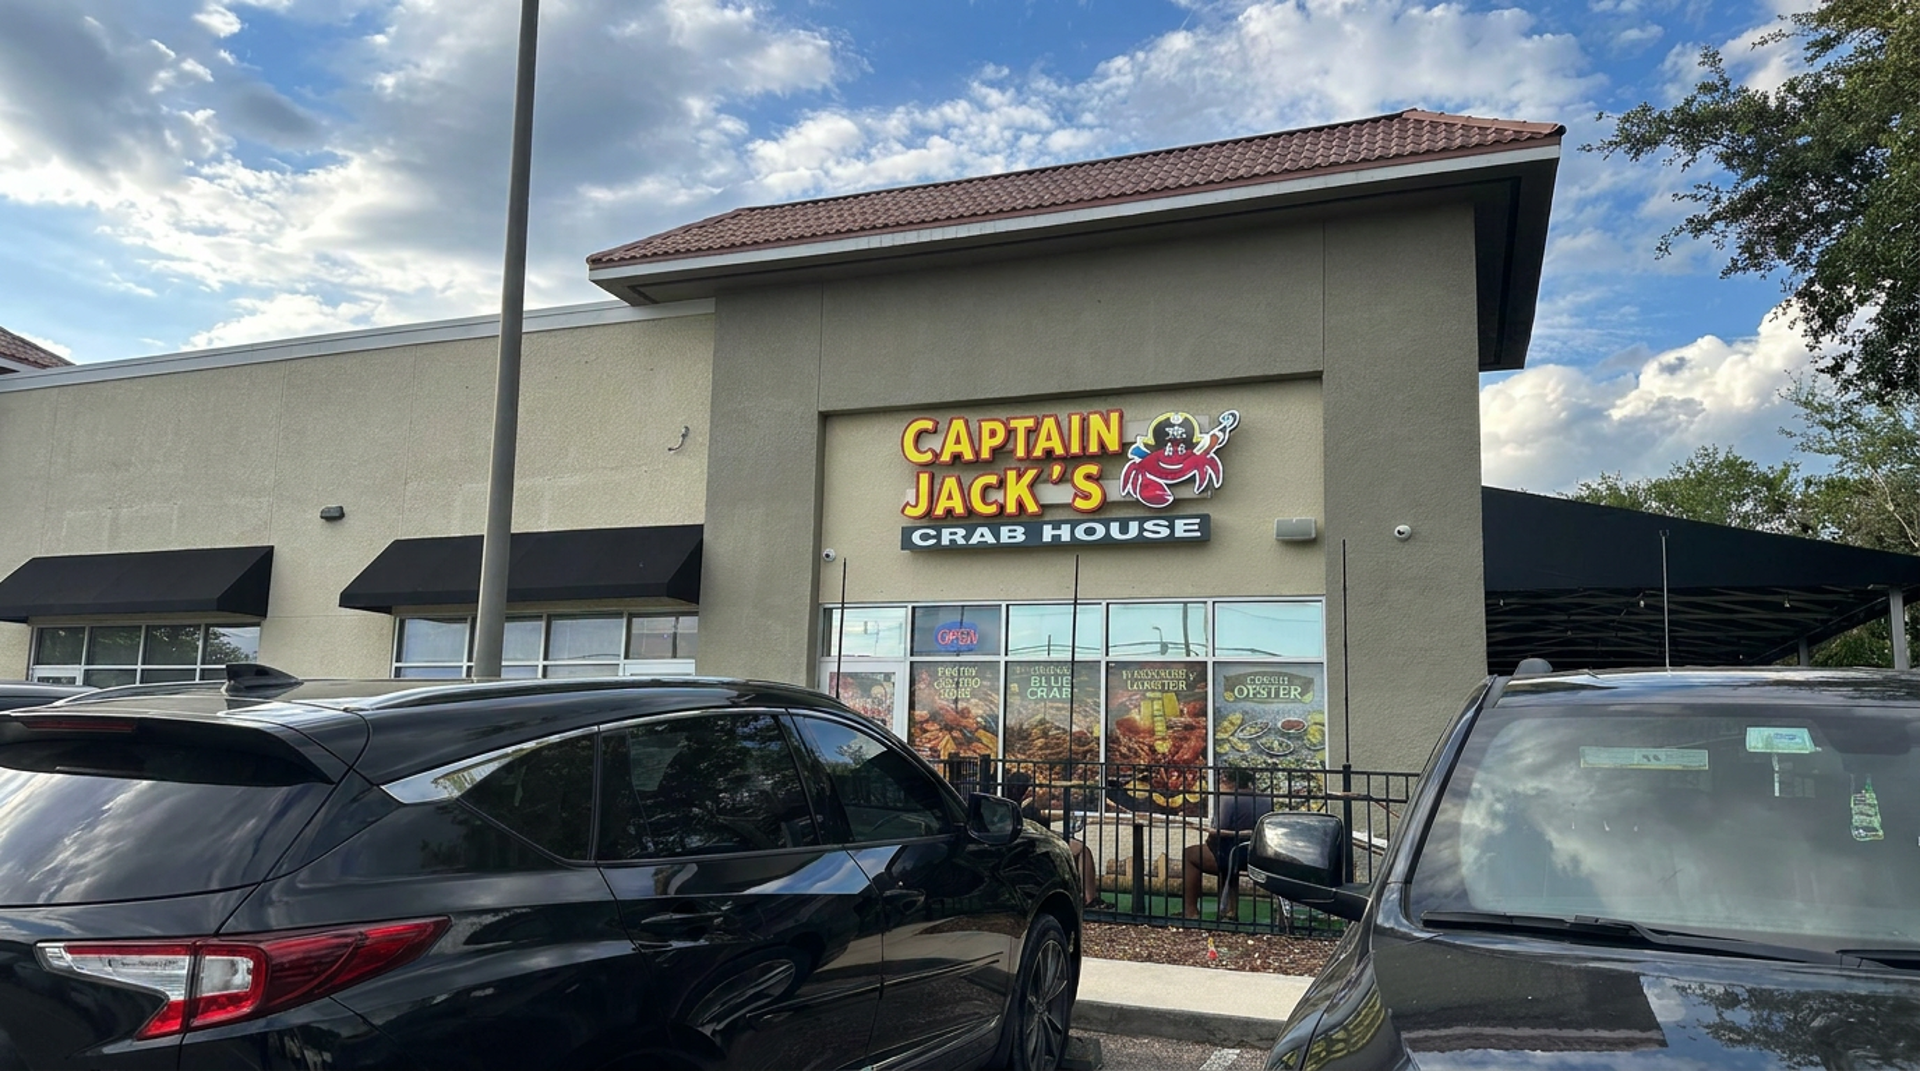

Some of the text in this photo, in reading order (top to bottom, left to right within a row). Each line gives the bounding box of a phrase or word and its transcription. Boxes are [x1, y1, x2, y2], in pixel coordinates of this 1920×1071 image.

[901, 409, 1123, 466] CAPTAIN
[901, 462, 1106, 519] JACK'S
[911, 518, 1201, 546] CRAB HOUSE
[938, 629, 978, 645] OPEN
[1031, 676, 1071, 687] BLUE
